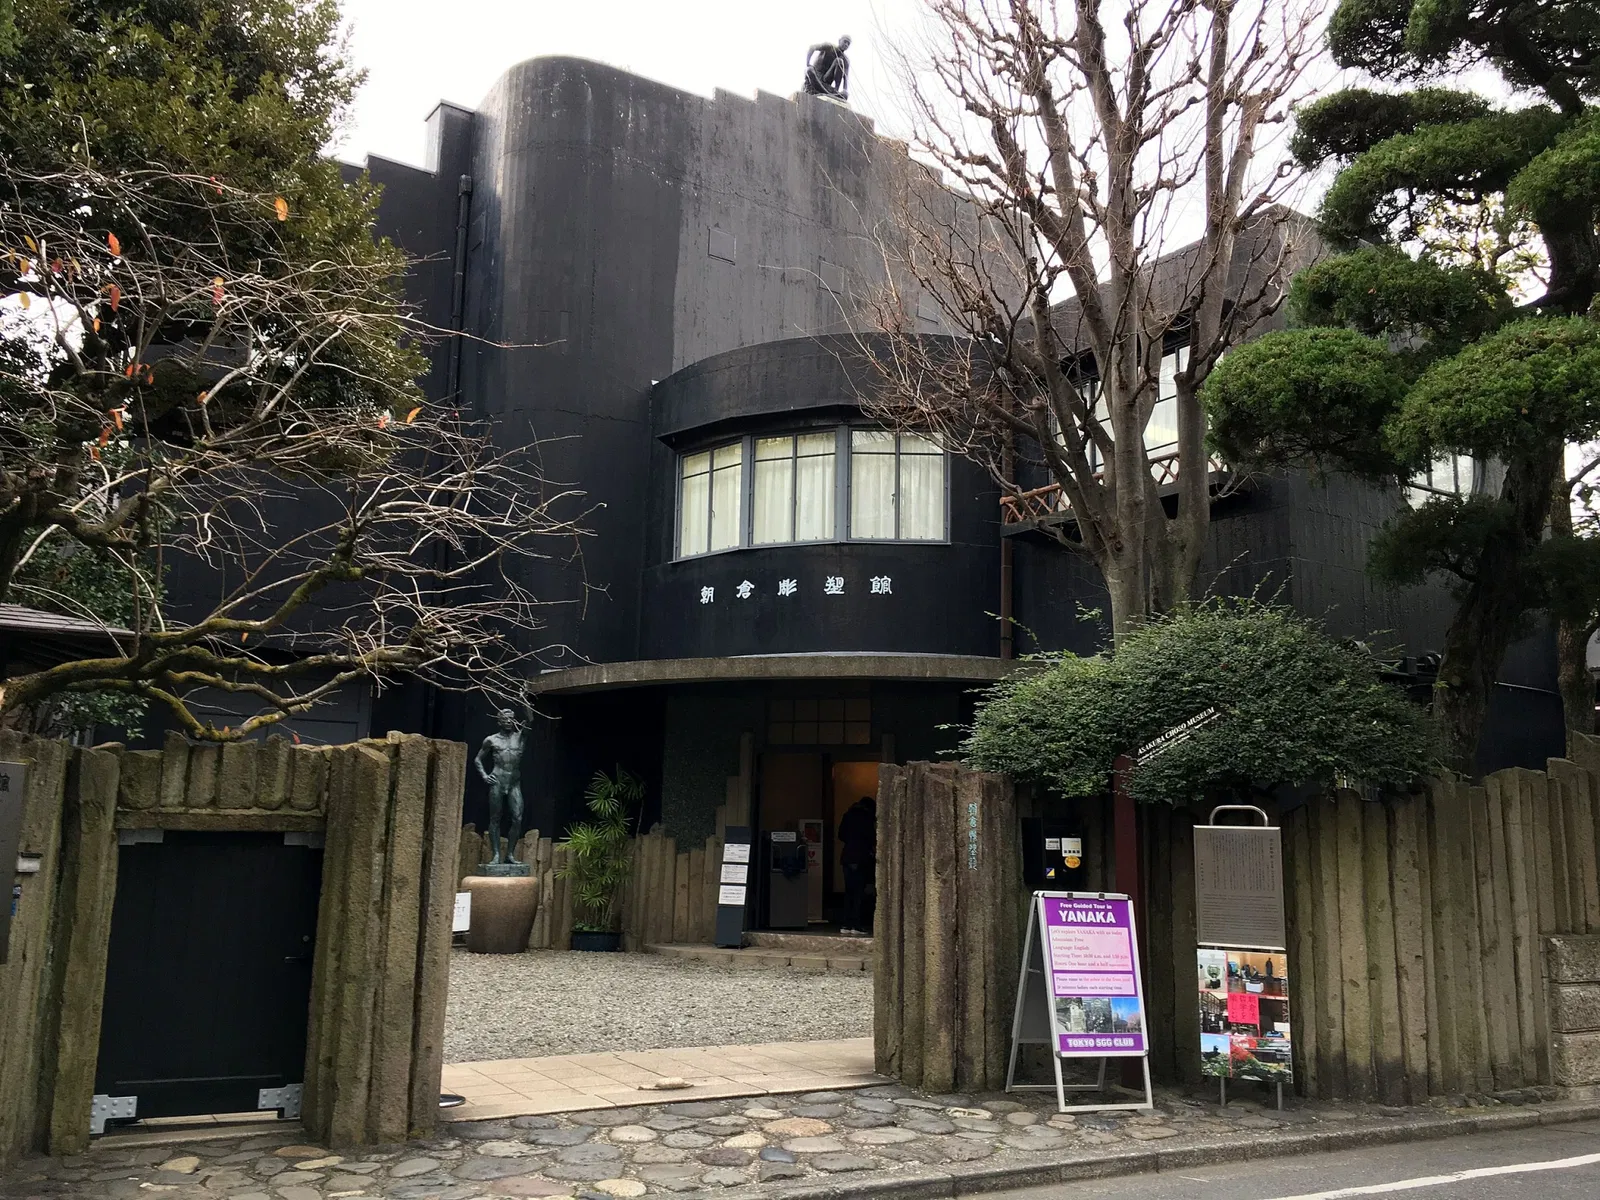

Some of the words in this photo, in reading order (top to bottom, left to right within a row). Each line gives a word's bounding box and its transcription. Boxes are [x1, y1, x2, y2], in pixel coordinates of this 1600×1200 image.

[1137, 735, 1165, 756] ASAKURA
[1165, 722, 1187, 739] CHOSO
[1186, 706, 1215, 727] MUSEUM
[1058, 910, 1117, 924] YANAKA
[1066, 1037, 1095, 1048] TOKYO
[1095, 1037, 1113, 1047] SGG
[1113, 1037, 1135, 1047] CLUB
